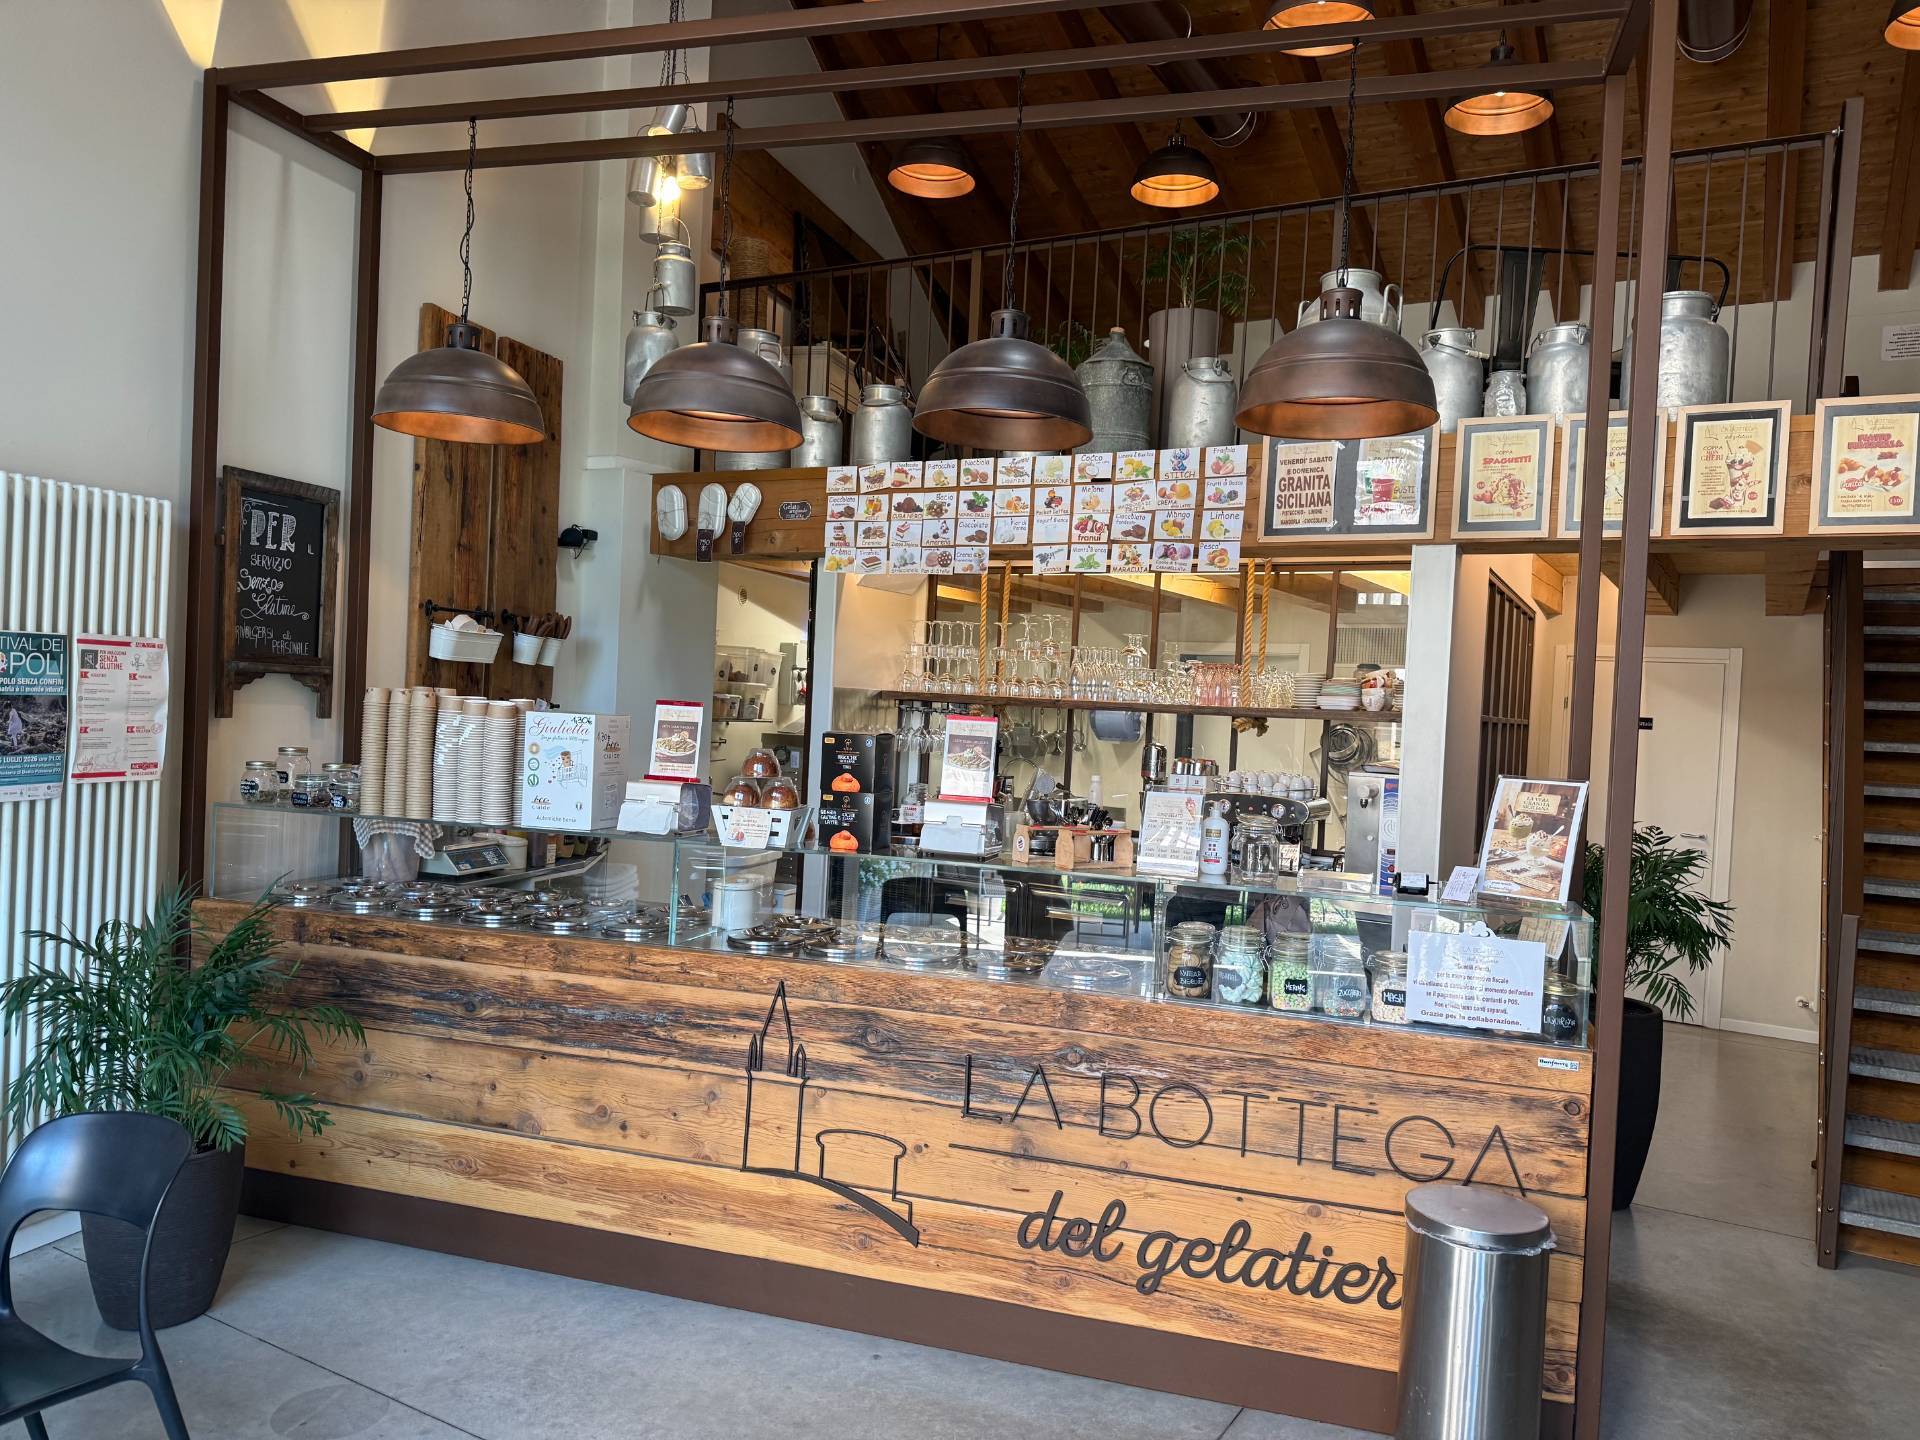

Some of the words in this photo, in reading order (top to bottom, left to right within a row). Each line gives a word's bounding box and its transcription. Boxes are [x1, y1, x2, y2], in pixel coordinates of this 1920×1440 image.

[1081, 454, 1103, 463] Cocco
[1308, 456, 1333, 464] SABATO
[1482, 454, 1532, 465] SPAGHETTI
[1165, 472, 1195, 480] STITCH
[1292, 467, 1325, 475] DOMENICA
[1278, 474, 1331, 493] GRANITA
[1276, 491, 1332, 510] SICILIANA
[1167, 510, 1191, 521] Mango
[1210, 511, 1240, 520] Limone
[249, 508, 297, 553] PER
[251, 552, 293, 572] SERVIZIO
[41, 637, 64, 652] DEI
[99, 662, 123, 670] GLUTINE
[17, 677, 38, 685] SENZA
[39, 678, 65, 686] CONFINI
[529, 714, 590, 737] Giulietta
[1420, 1009, 1444, 1018] Grazie
[1467, 1014, 1523, 1026] collaborazione.
[961, 1054, 1063, 1131] LA
[1099, 1073, 1527, 1199] BOTTEGA
[1016, 1190, 1127, 1262] del
[1136, 1219, 1404, 1311] gelatier
